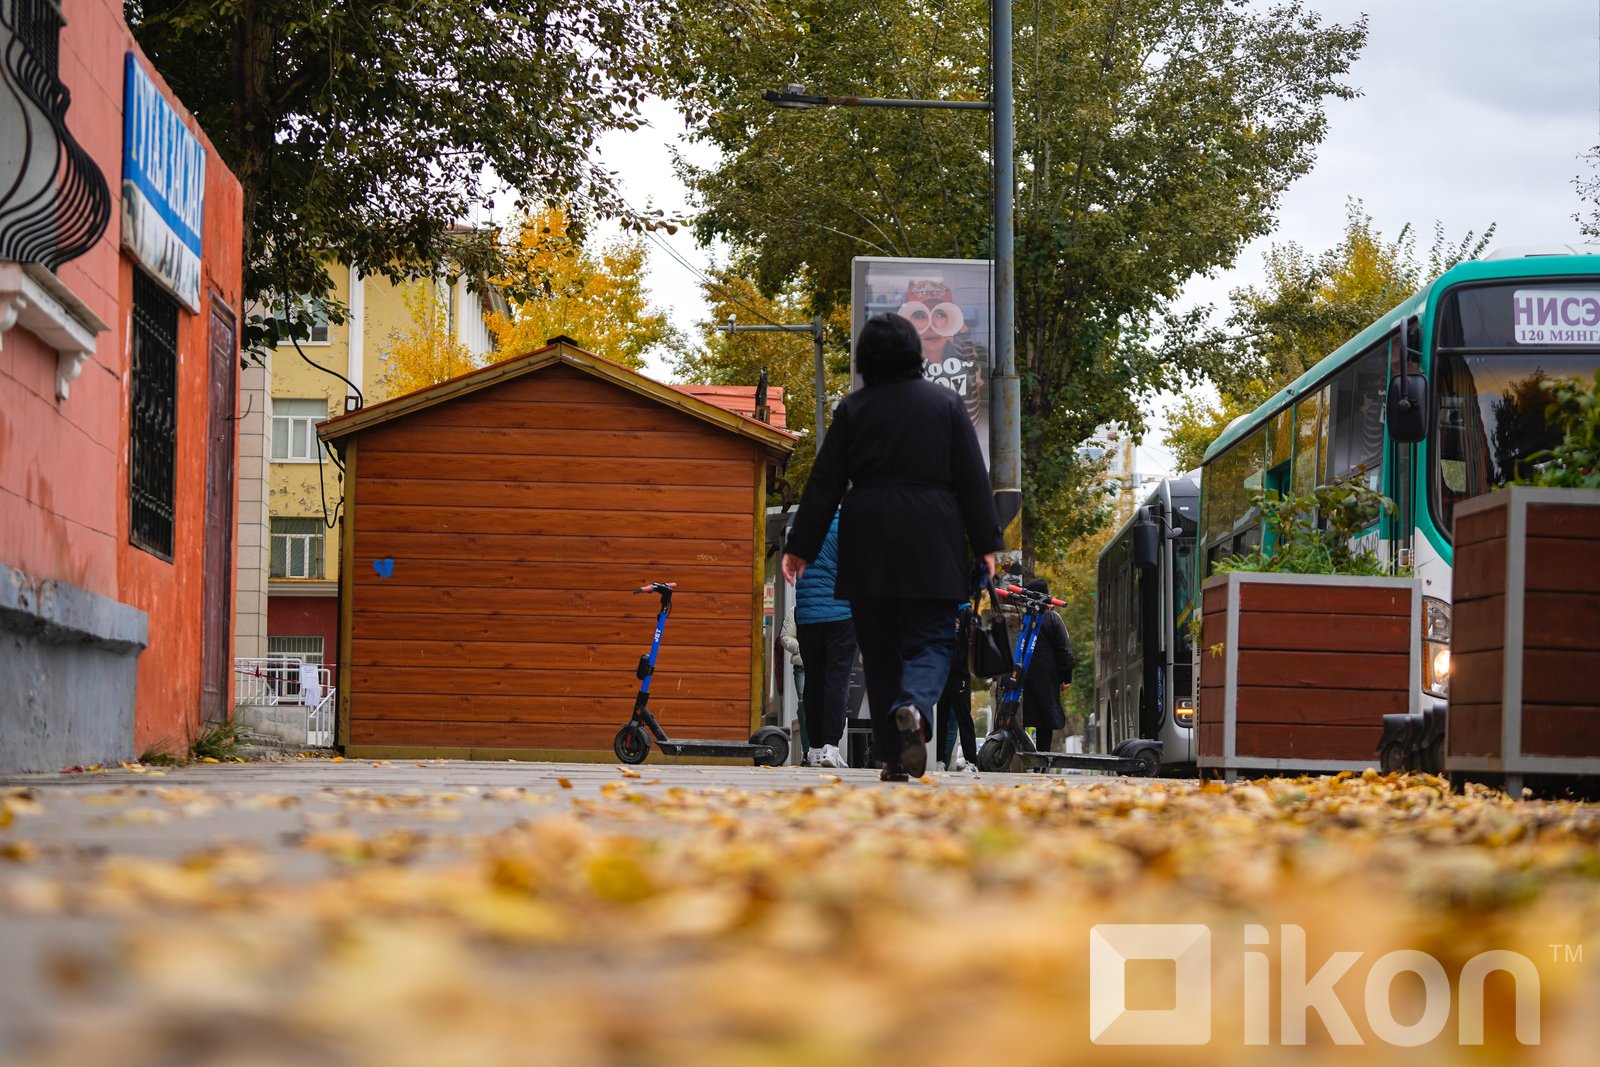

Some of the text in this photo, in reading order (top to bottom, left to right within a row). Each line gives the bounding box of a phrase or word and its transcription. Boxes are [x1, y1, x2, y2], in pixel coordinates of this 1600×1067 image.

[1514, 297, 1600, 326] НИСЭ
[1520, 330, 1600, 341] 120 МЯНГ
[654, 628, 662, 642] JET
